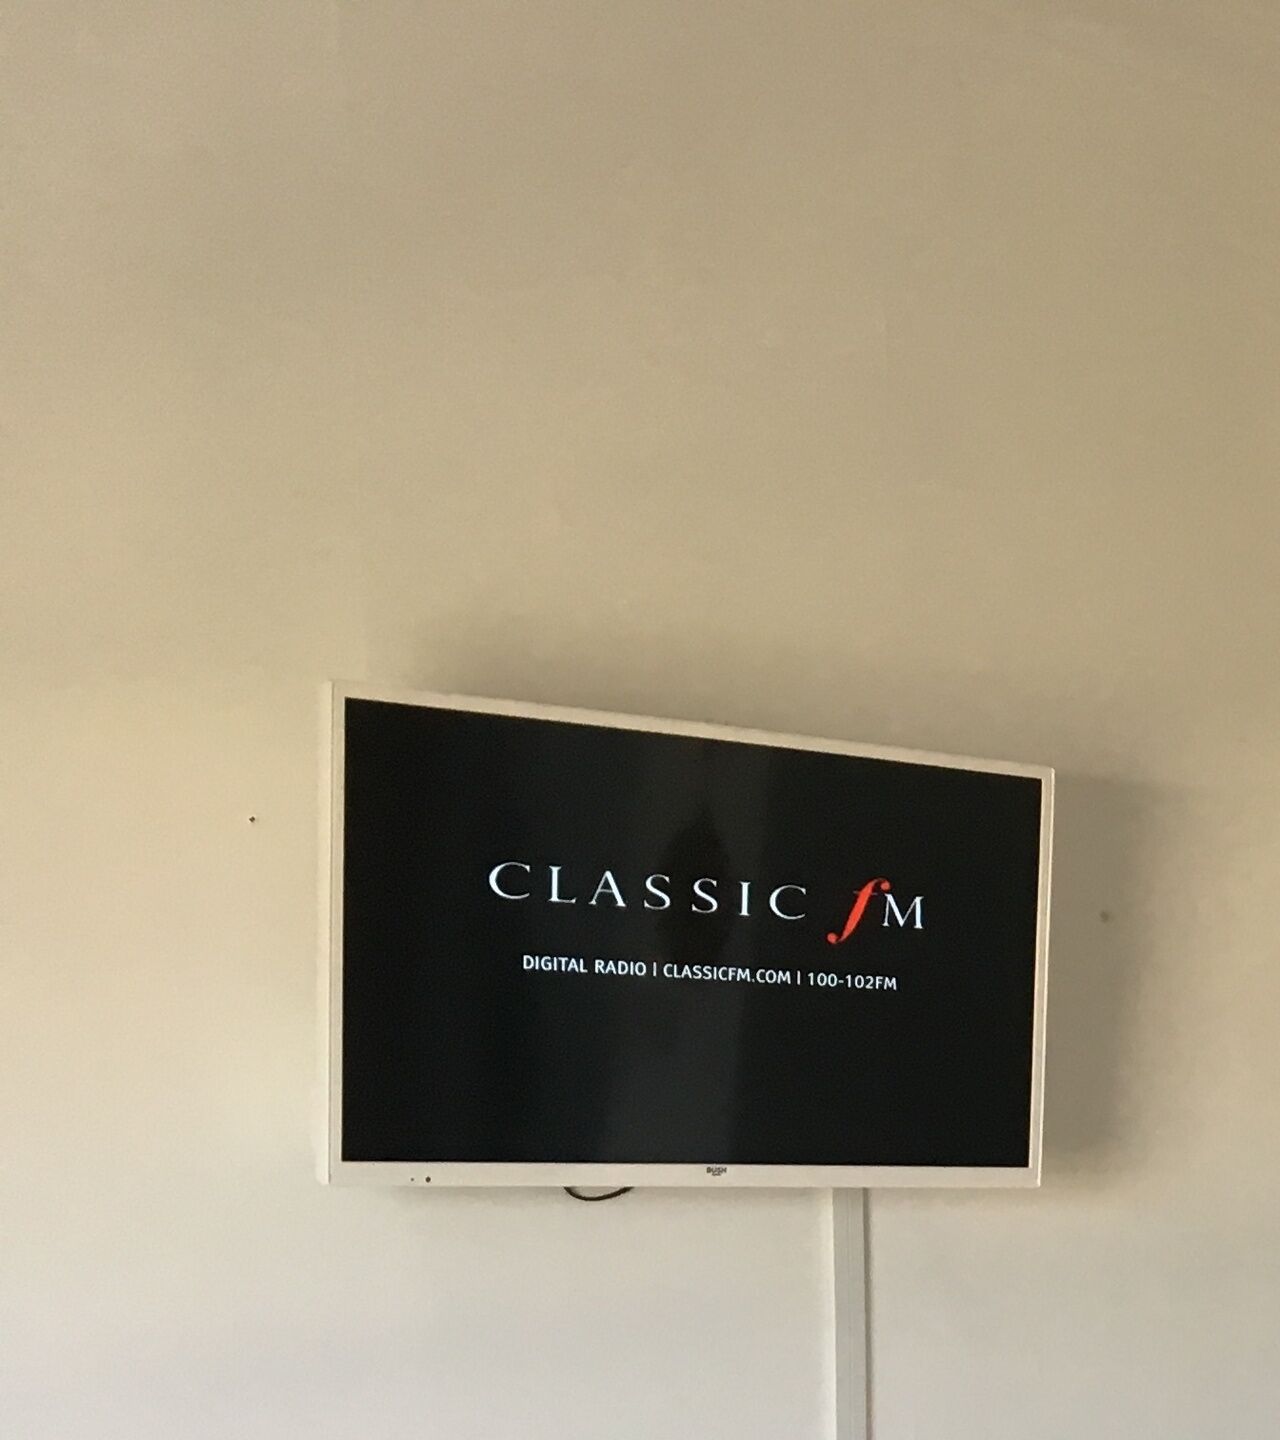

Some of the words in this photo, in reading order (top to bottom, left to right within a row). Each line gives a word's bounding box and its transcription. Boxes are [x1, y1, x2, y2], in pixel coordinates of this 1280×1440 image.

[488, 861, 808, 921] CLASSIC
[522, 954, 588, 975] DIGITAL
[594, 959, 647, 977] RADIO
[662, 963, 792, 986] CLASSICFM.COM
[807, 972, 898, 992] 100-102FM
